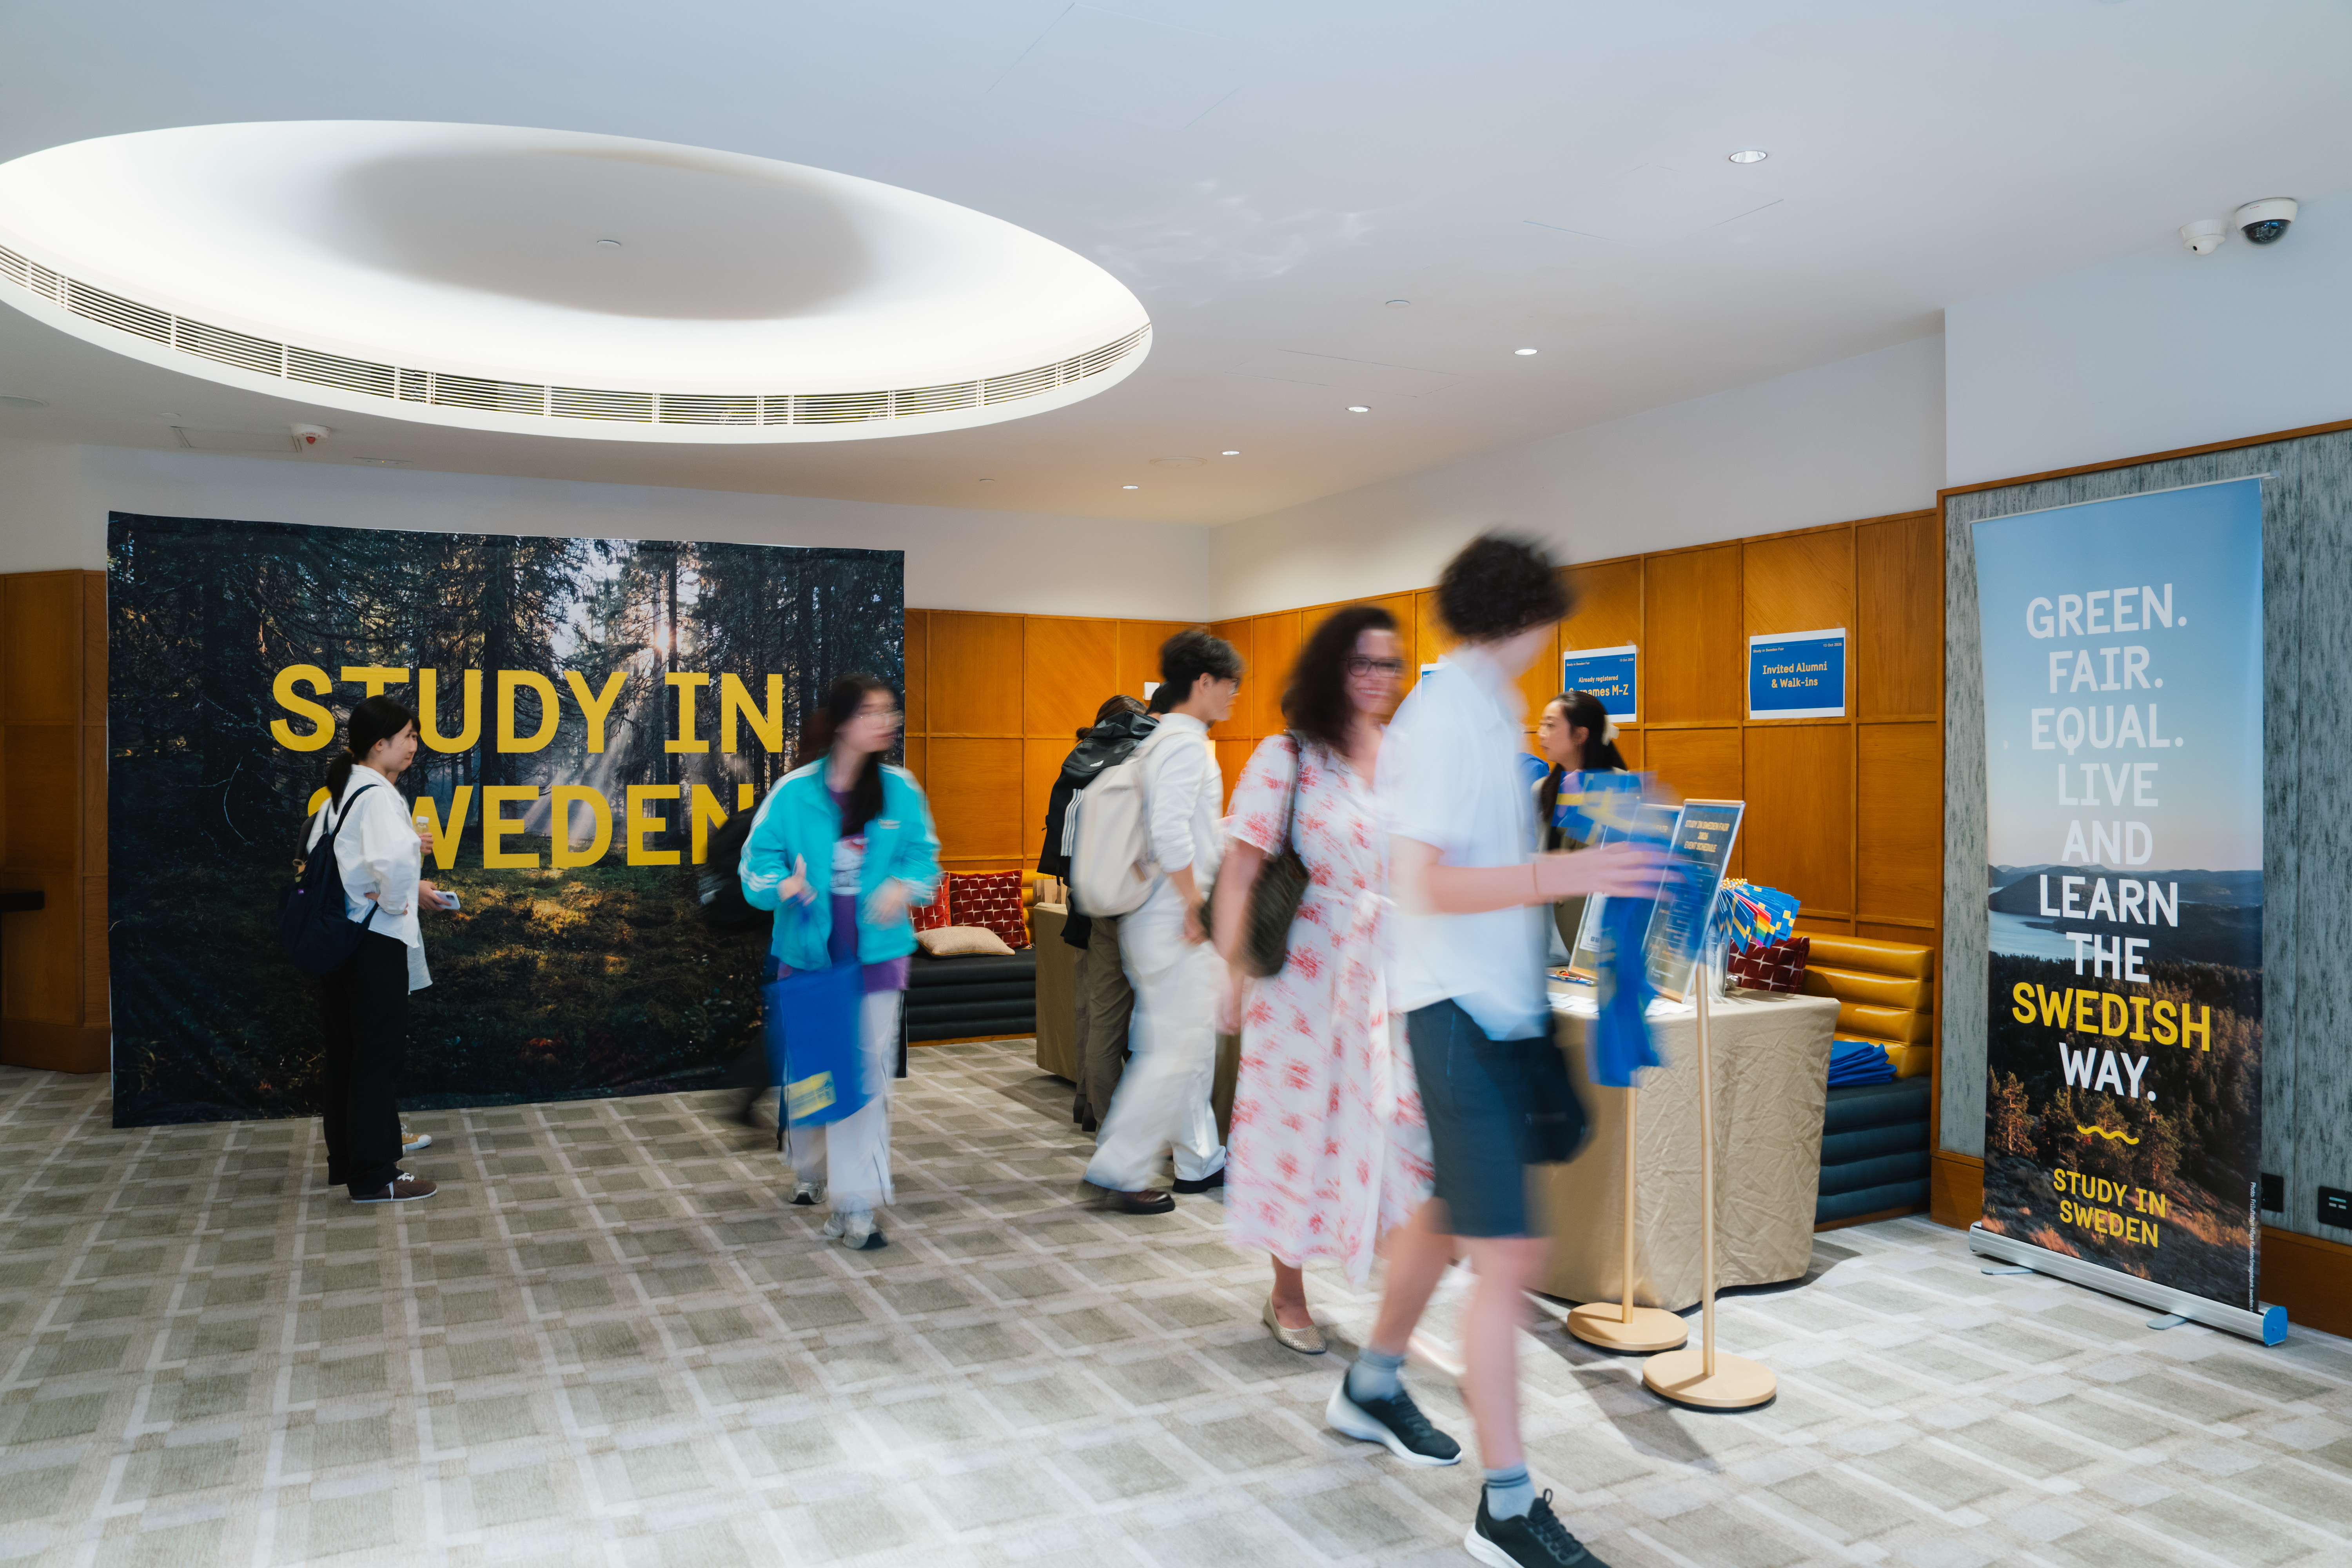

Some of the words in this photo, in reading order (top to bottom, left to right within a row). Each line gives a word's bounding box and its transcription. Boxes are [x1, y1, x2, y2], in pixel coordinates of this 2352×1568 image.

[2026, 583, 2187, 639] GREEN.
[1612, 684, 1628, 695] M-Z
[1762, 663, 1794, 674] Invited
[1796, 661, 1828, 672] Alumni
[1771, 679, 1778, 688] &
[1780, 677, 1818, 687] Walk-ins
[2049, 646, 2163, 693] FAIR.
[664, 673, 782, 753] IN
[2031, 704, 2183, 755] EQUAL.
[2058, 763, 2158, 807] LIVE
[308, 784, 754, 870] WEDEN
[2062, 820, 2153, 865] AND
[2040, 874, 2178, 927] LEARN
[2066, 931, 2149, 983] THE
[2012, 982, 2210, 1051] SWEDISH
[2059, 1042, 2156, 1102] WAY.
[2053, 1168, 2128, 1207] STUDY
[2135, 1187, 2165, 1218] IN
[2060, 1200, 2158, 1248] SWEDEN
